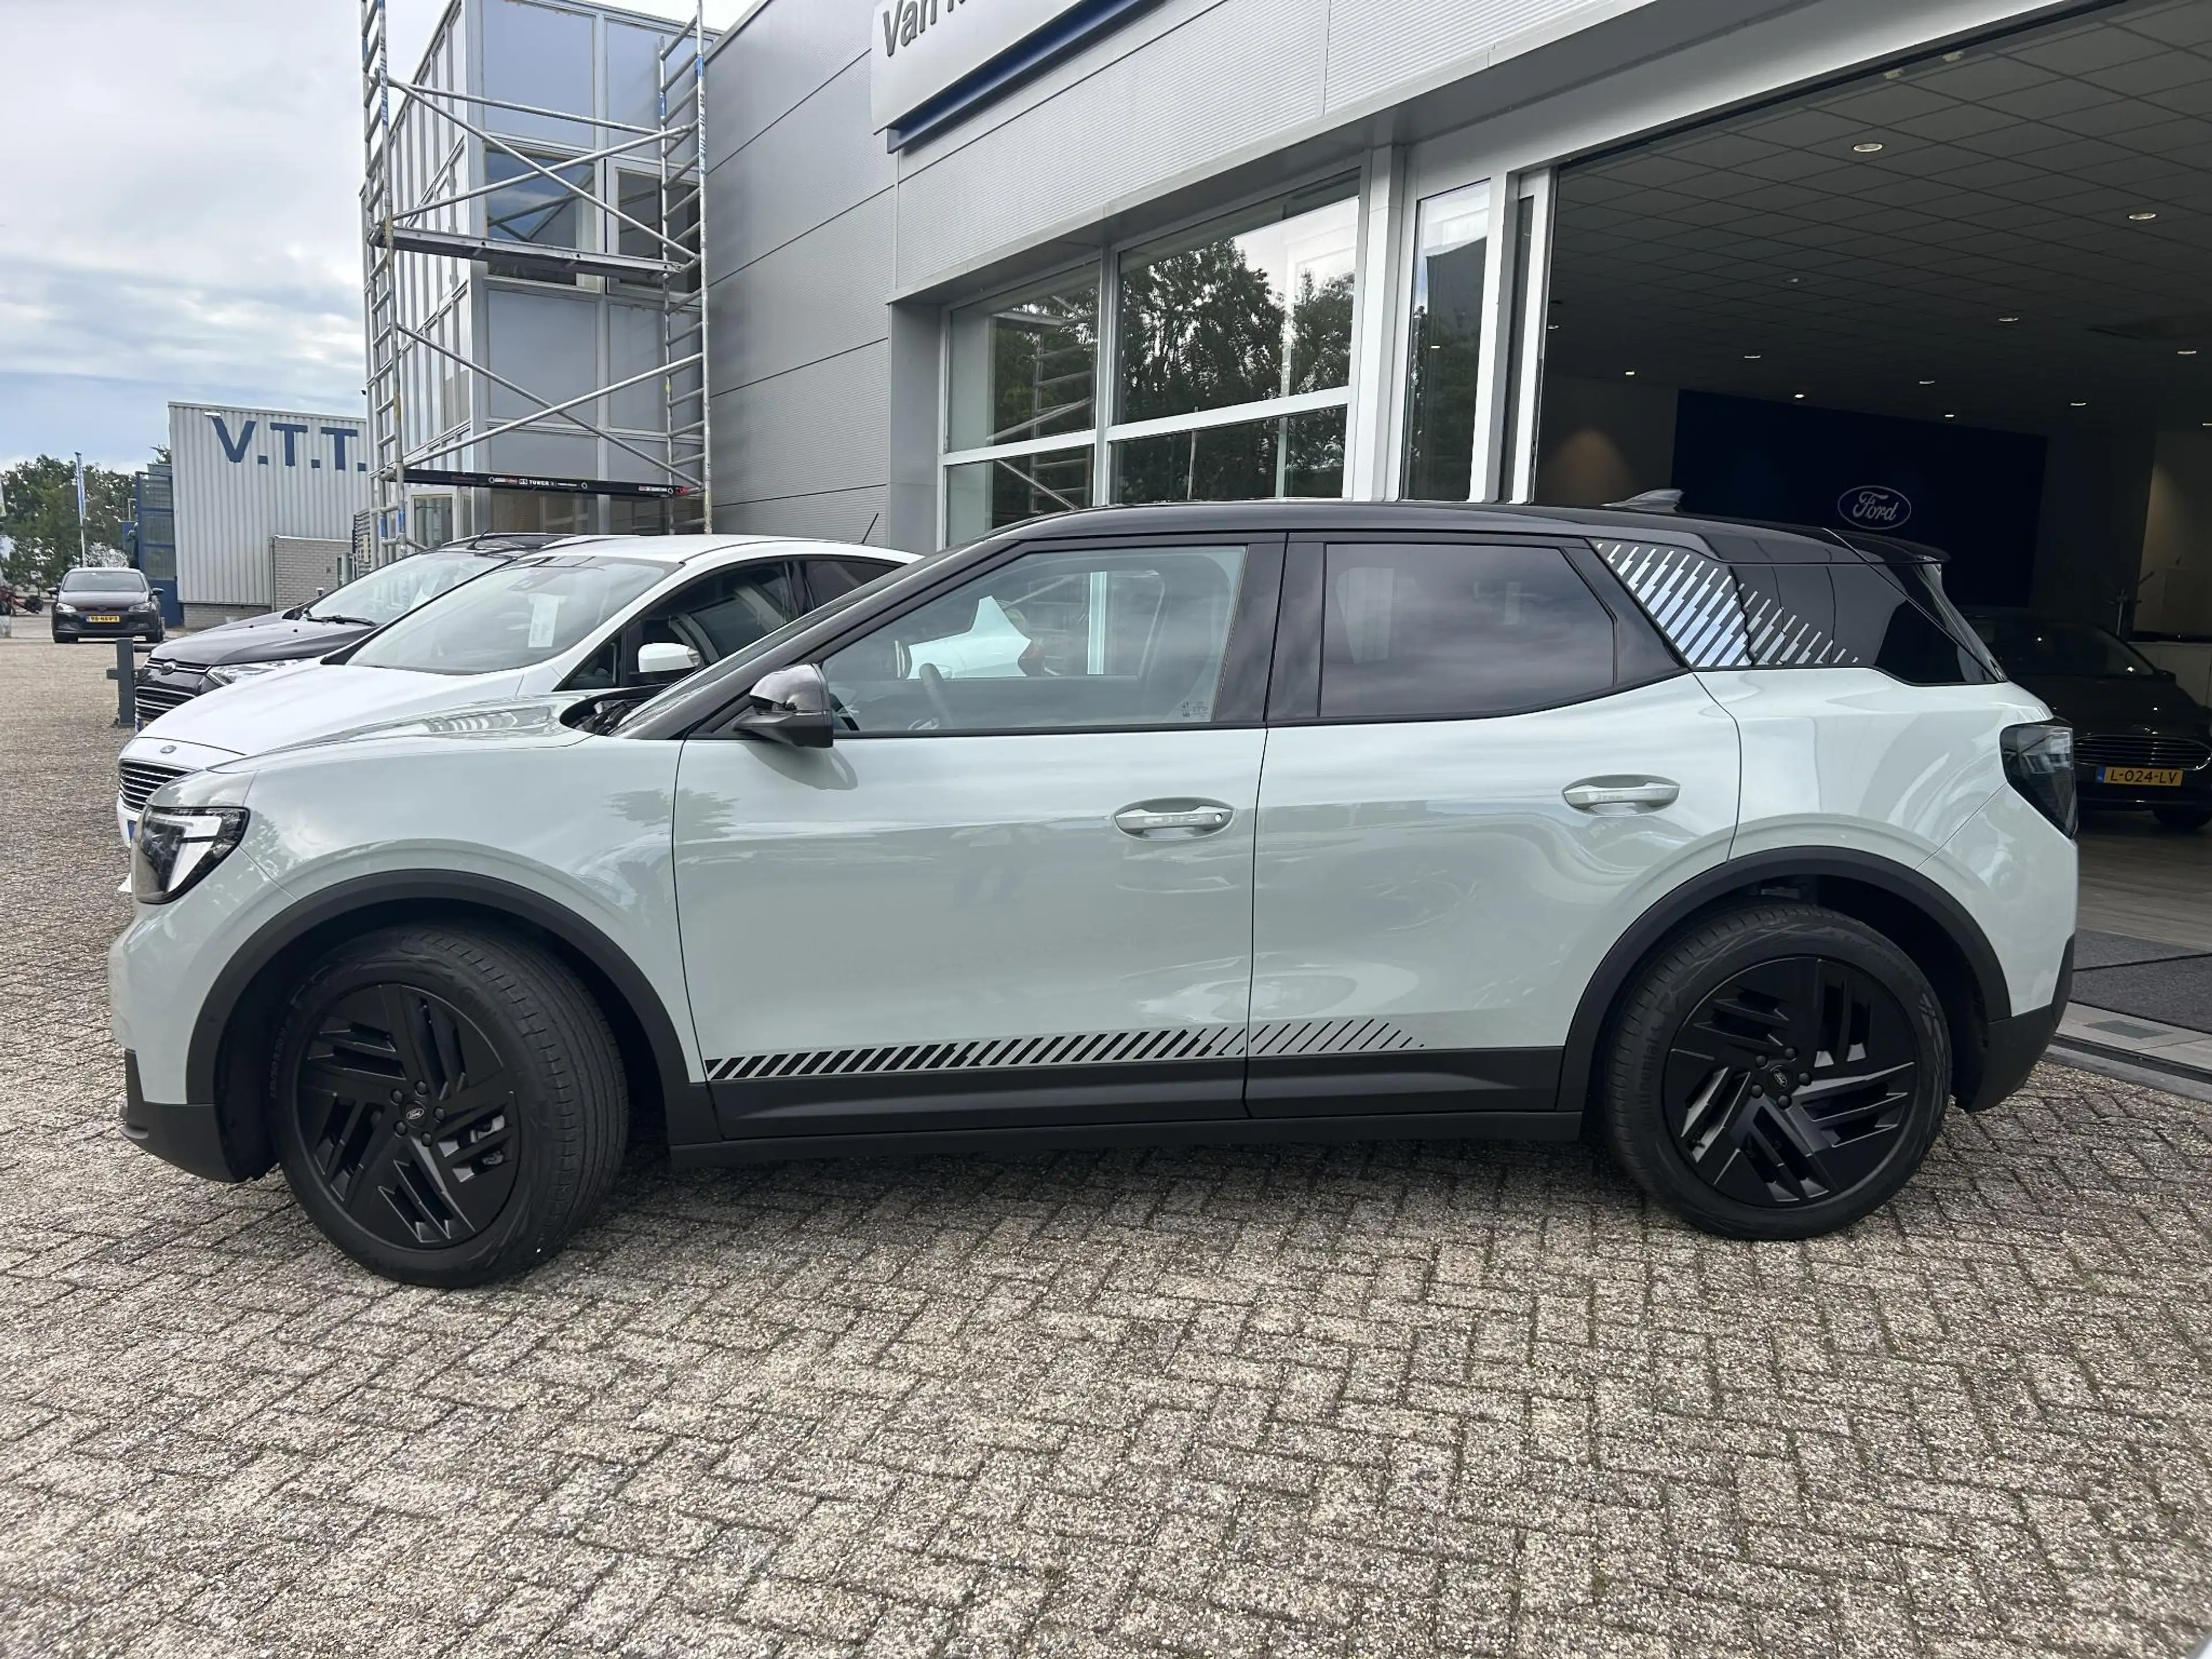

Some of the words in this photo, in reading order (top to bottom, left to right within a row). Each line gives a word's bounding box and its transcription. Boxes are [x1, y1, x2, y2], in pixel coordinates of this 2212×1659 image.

[882, 0, 937, 56] Van
[212, 417, 366, 472] V.T.T.
[1853, 491, 1899, 521] Ford
[2110, 769, 2177, 784] L-024-LV
